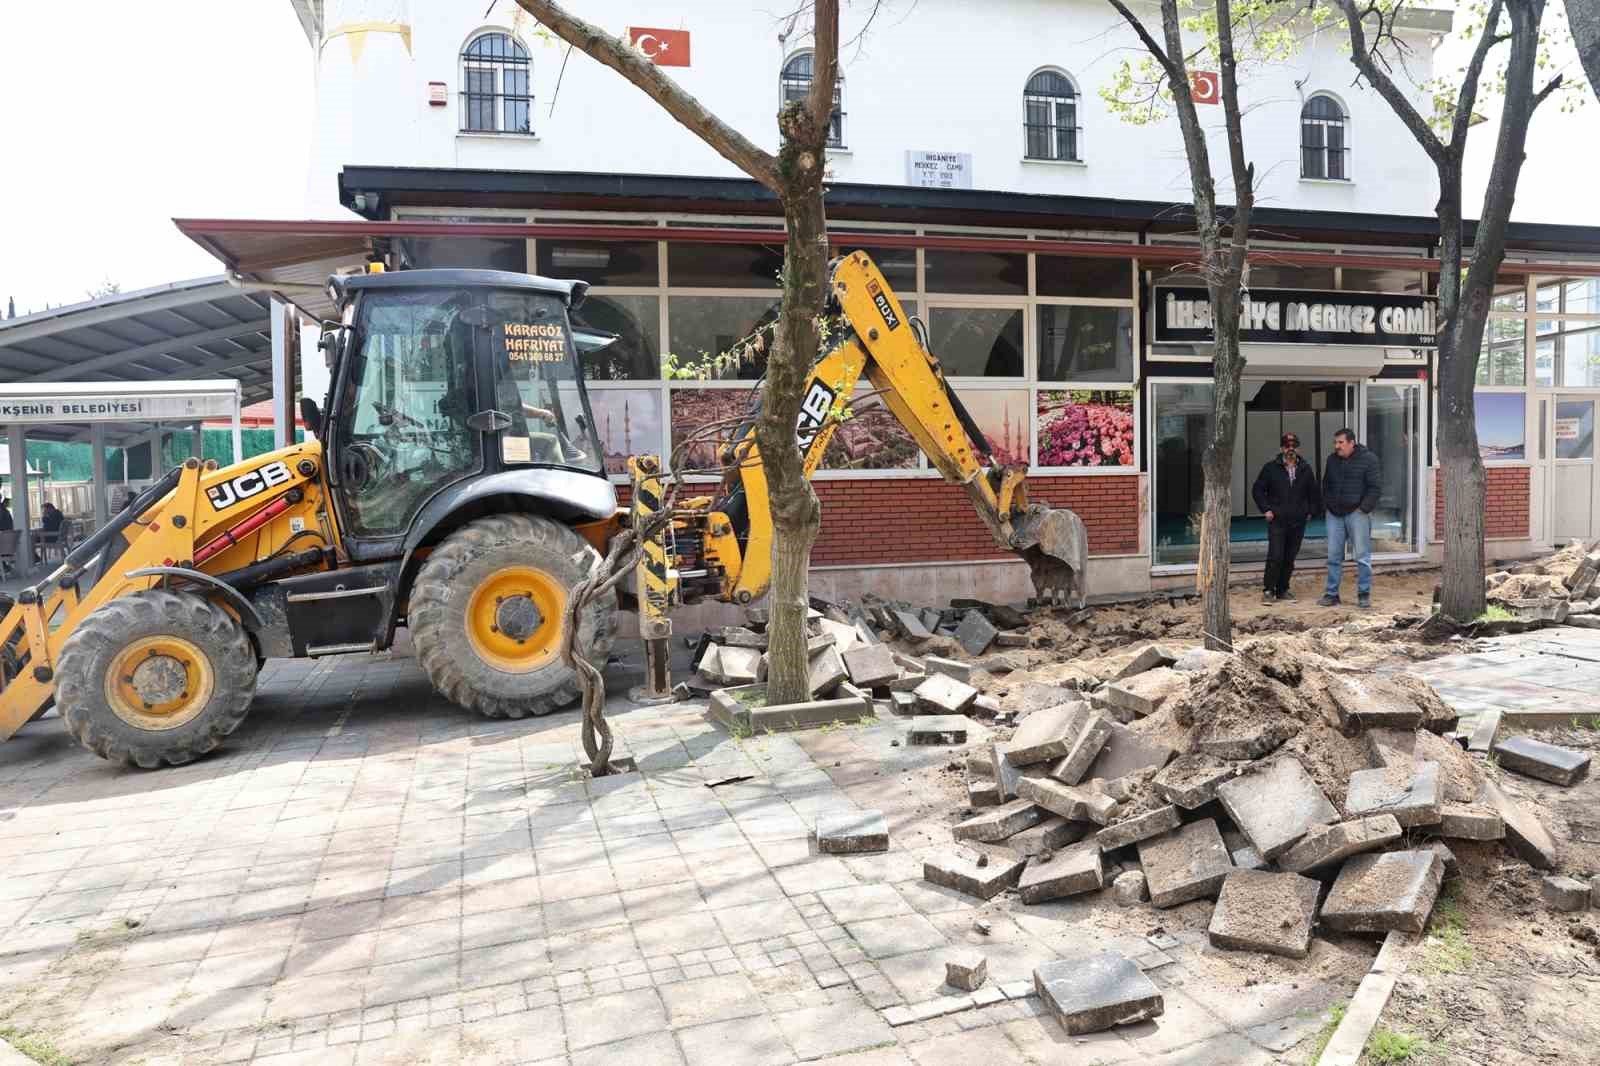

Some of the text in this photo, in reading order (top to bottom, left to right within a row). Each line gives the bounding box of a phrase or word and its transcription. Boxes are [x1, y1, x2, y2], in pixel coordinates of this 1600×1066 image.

[1166, 292, 1280, 331] İHSİYE
[1285, 302, 1376, 334] MERKEZ
[504, 323, 562, 337] KARAGÖZ
[504, 337, 564, 352] HAFRİYAT
[0, 401, 143, 416] KŞEHİR BELEDİYESİ
[796, 382, 834, 457] CB
[211, 461, 293, 509] JCB
